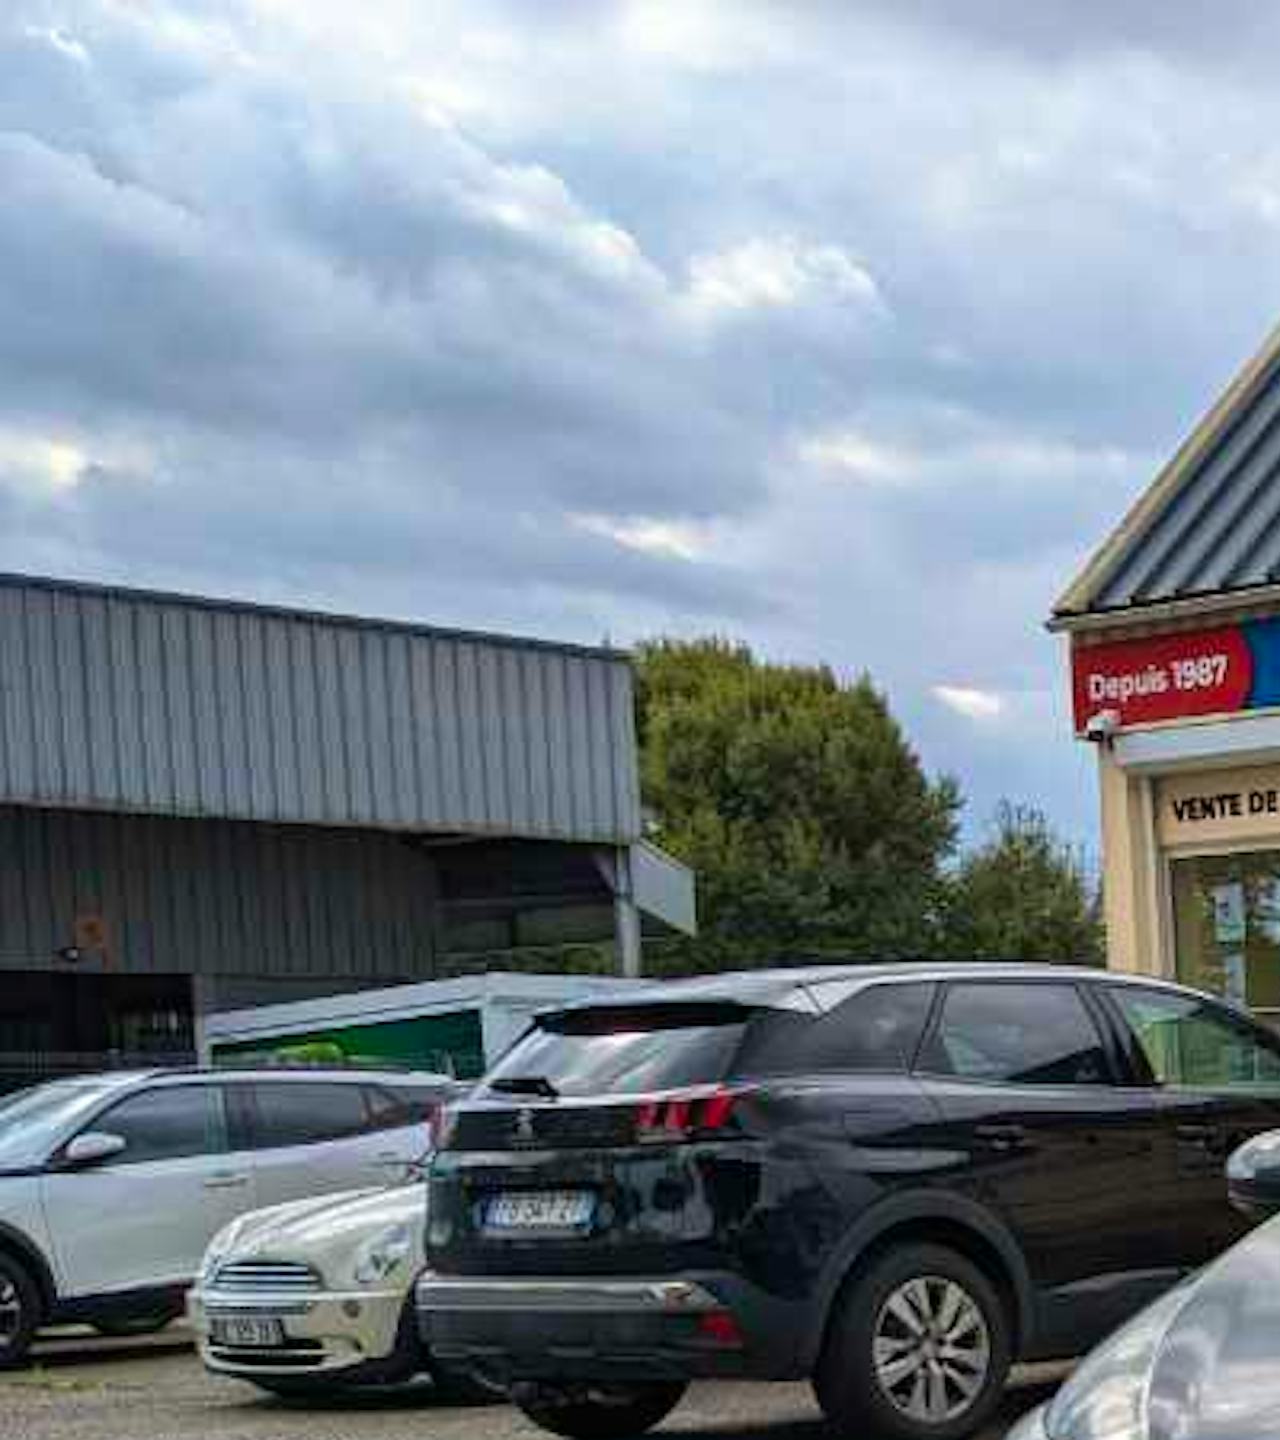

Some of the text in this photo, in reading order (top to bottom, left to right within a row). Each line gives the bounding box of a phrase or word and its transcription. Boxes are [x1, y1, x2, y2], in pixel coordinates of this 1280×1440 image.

[1089, 654, 1228, 702] Depuis 1987
[1173, 789, 1242, 821] VENTE
[1249, 787, 1277, 814] DE
